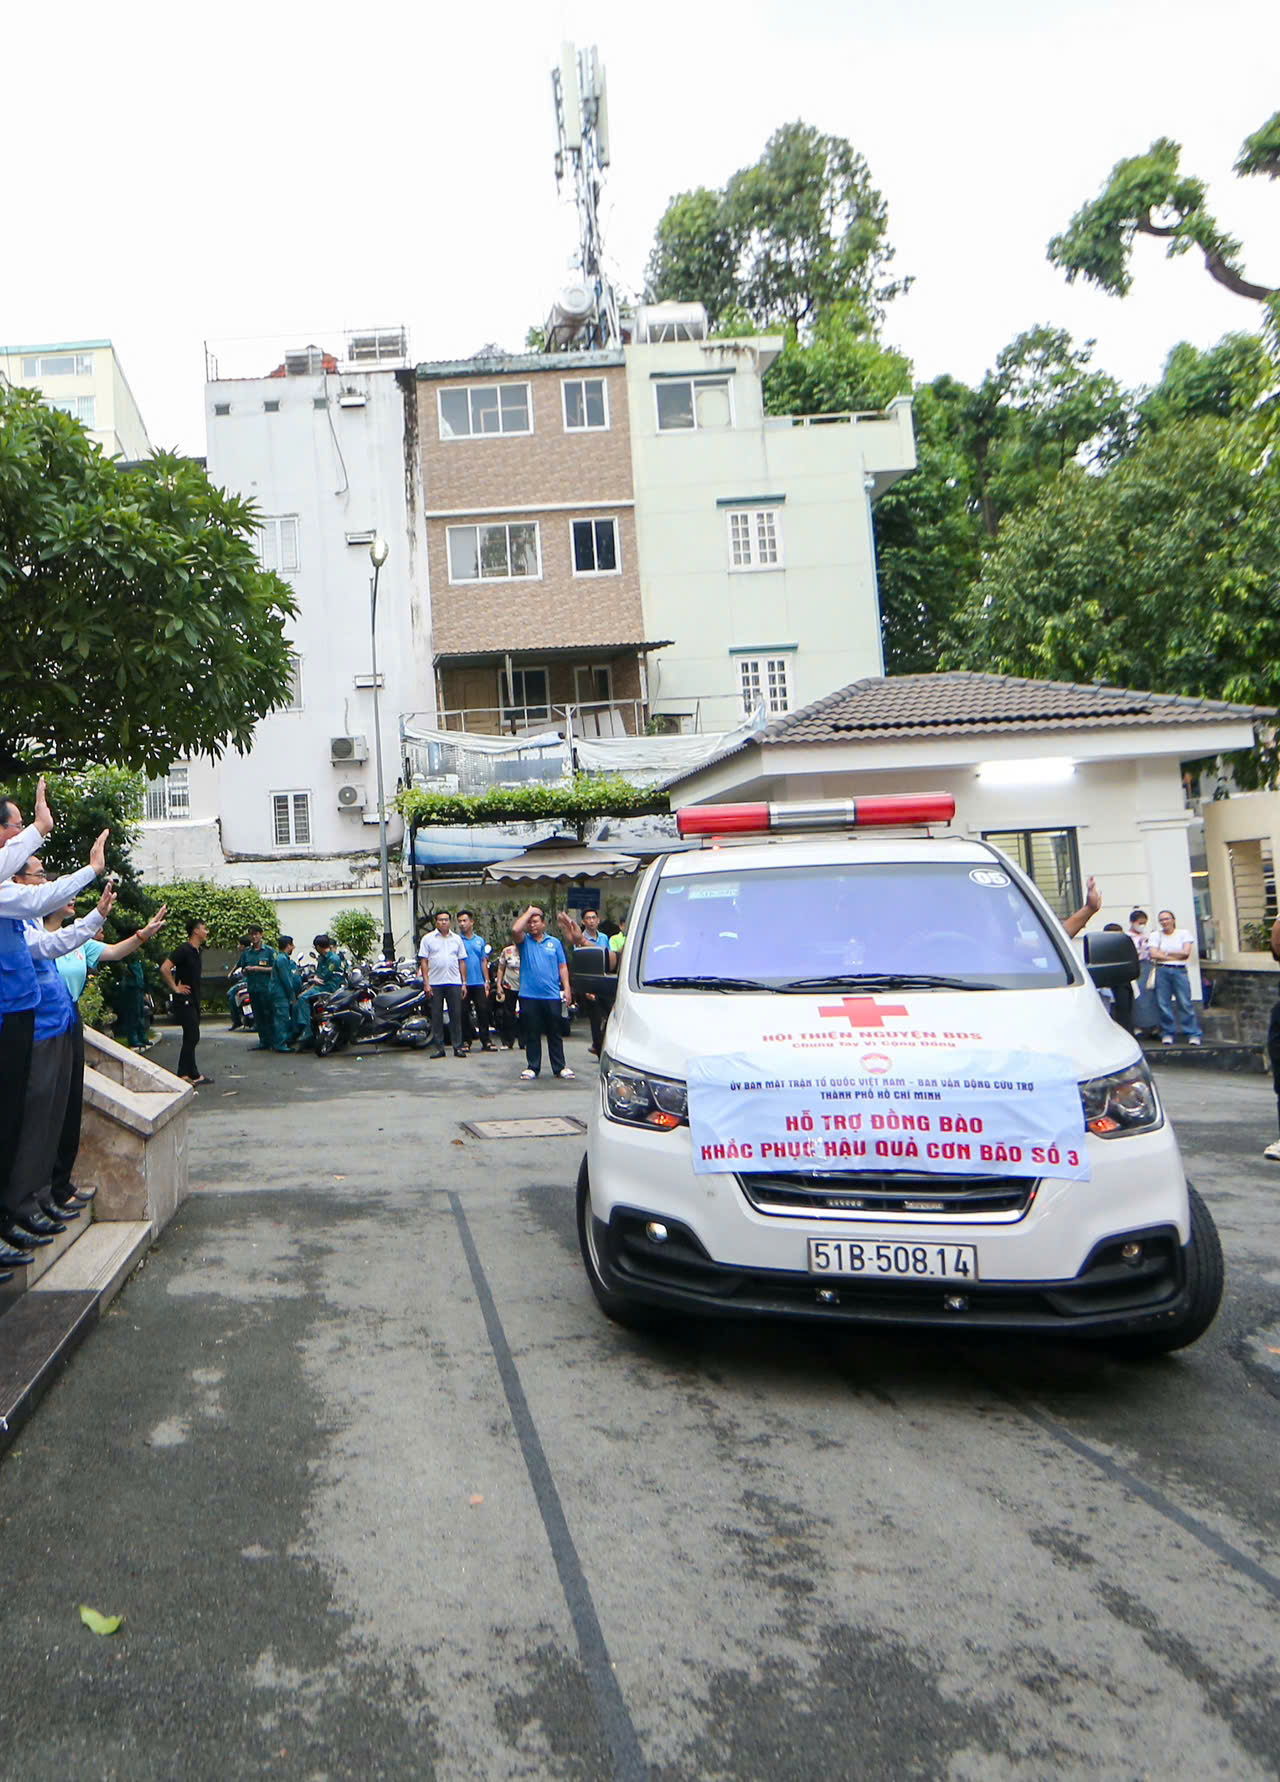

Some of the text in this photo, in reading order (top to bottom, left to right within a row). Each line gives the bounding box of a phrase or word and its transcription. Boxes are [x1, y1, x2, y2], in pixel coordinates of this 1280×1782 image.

[744, 1080, 762, 1090] BAN
[882, 1078, 906, 1087] NAM
[917, 1078, 938, 1088] BAN
[914, 1090, 942, 1100] MINH
[785, 1108, 984, 1134] HỖ TRỢ ĐỒNG BÀO
[701, 1136, 1080, 1166] KHẮC PHỤC HẬU QUẢ CƠN BÃO SỐ 3
[814, 1244, 969, 1276] 51B-508.14
